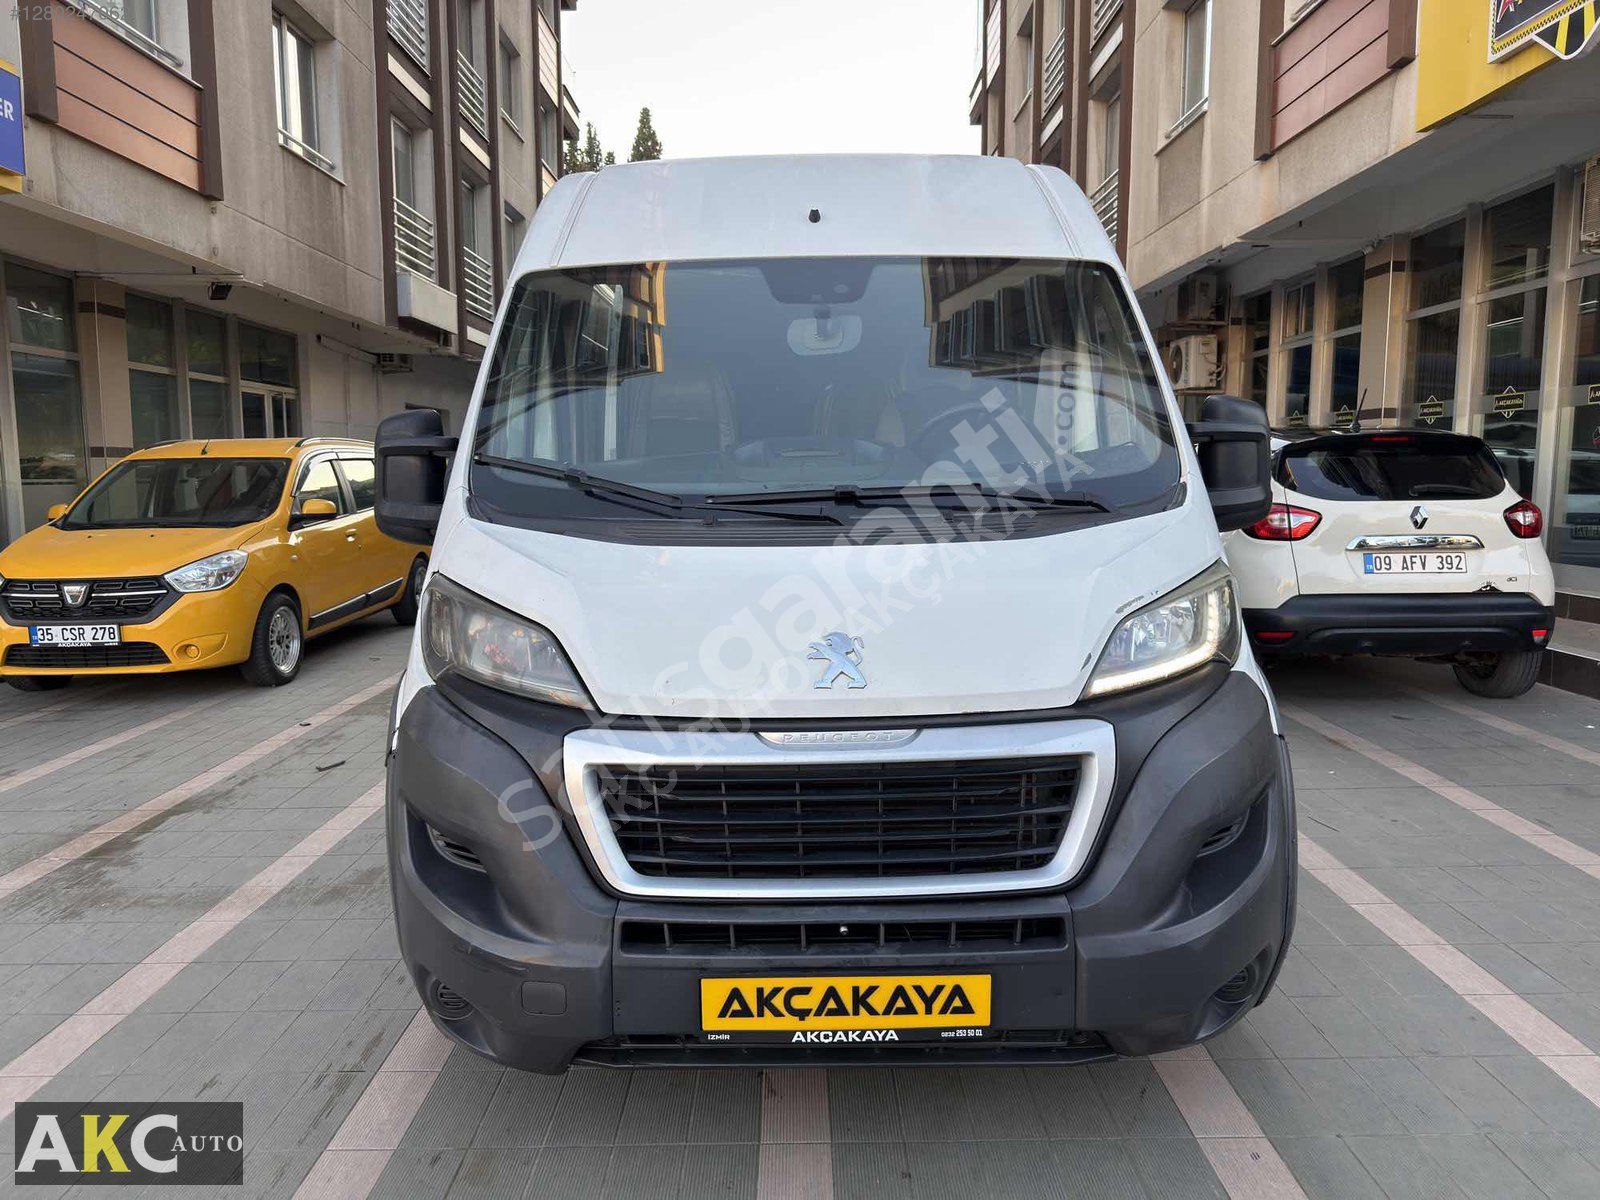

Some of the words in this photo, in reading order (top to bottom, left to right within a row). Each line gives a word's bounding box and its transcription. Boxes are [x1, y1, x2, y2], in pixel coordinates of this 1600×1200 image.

[1373, 555, 1392, 571] 09
[1401, 554, 1427, 571] AFV
[1435, 554, 1463, 571] 392
[37, 627, 54, 642] 35
[61, 627, 86, 642] CSR
[91, 626, 116, 641] 278
[782, 731, 895, 743] PEUGEOT
[716, 983, 976, 1022] AKÇAKAYA
[956, 1029, 967, 1037] 253
